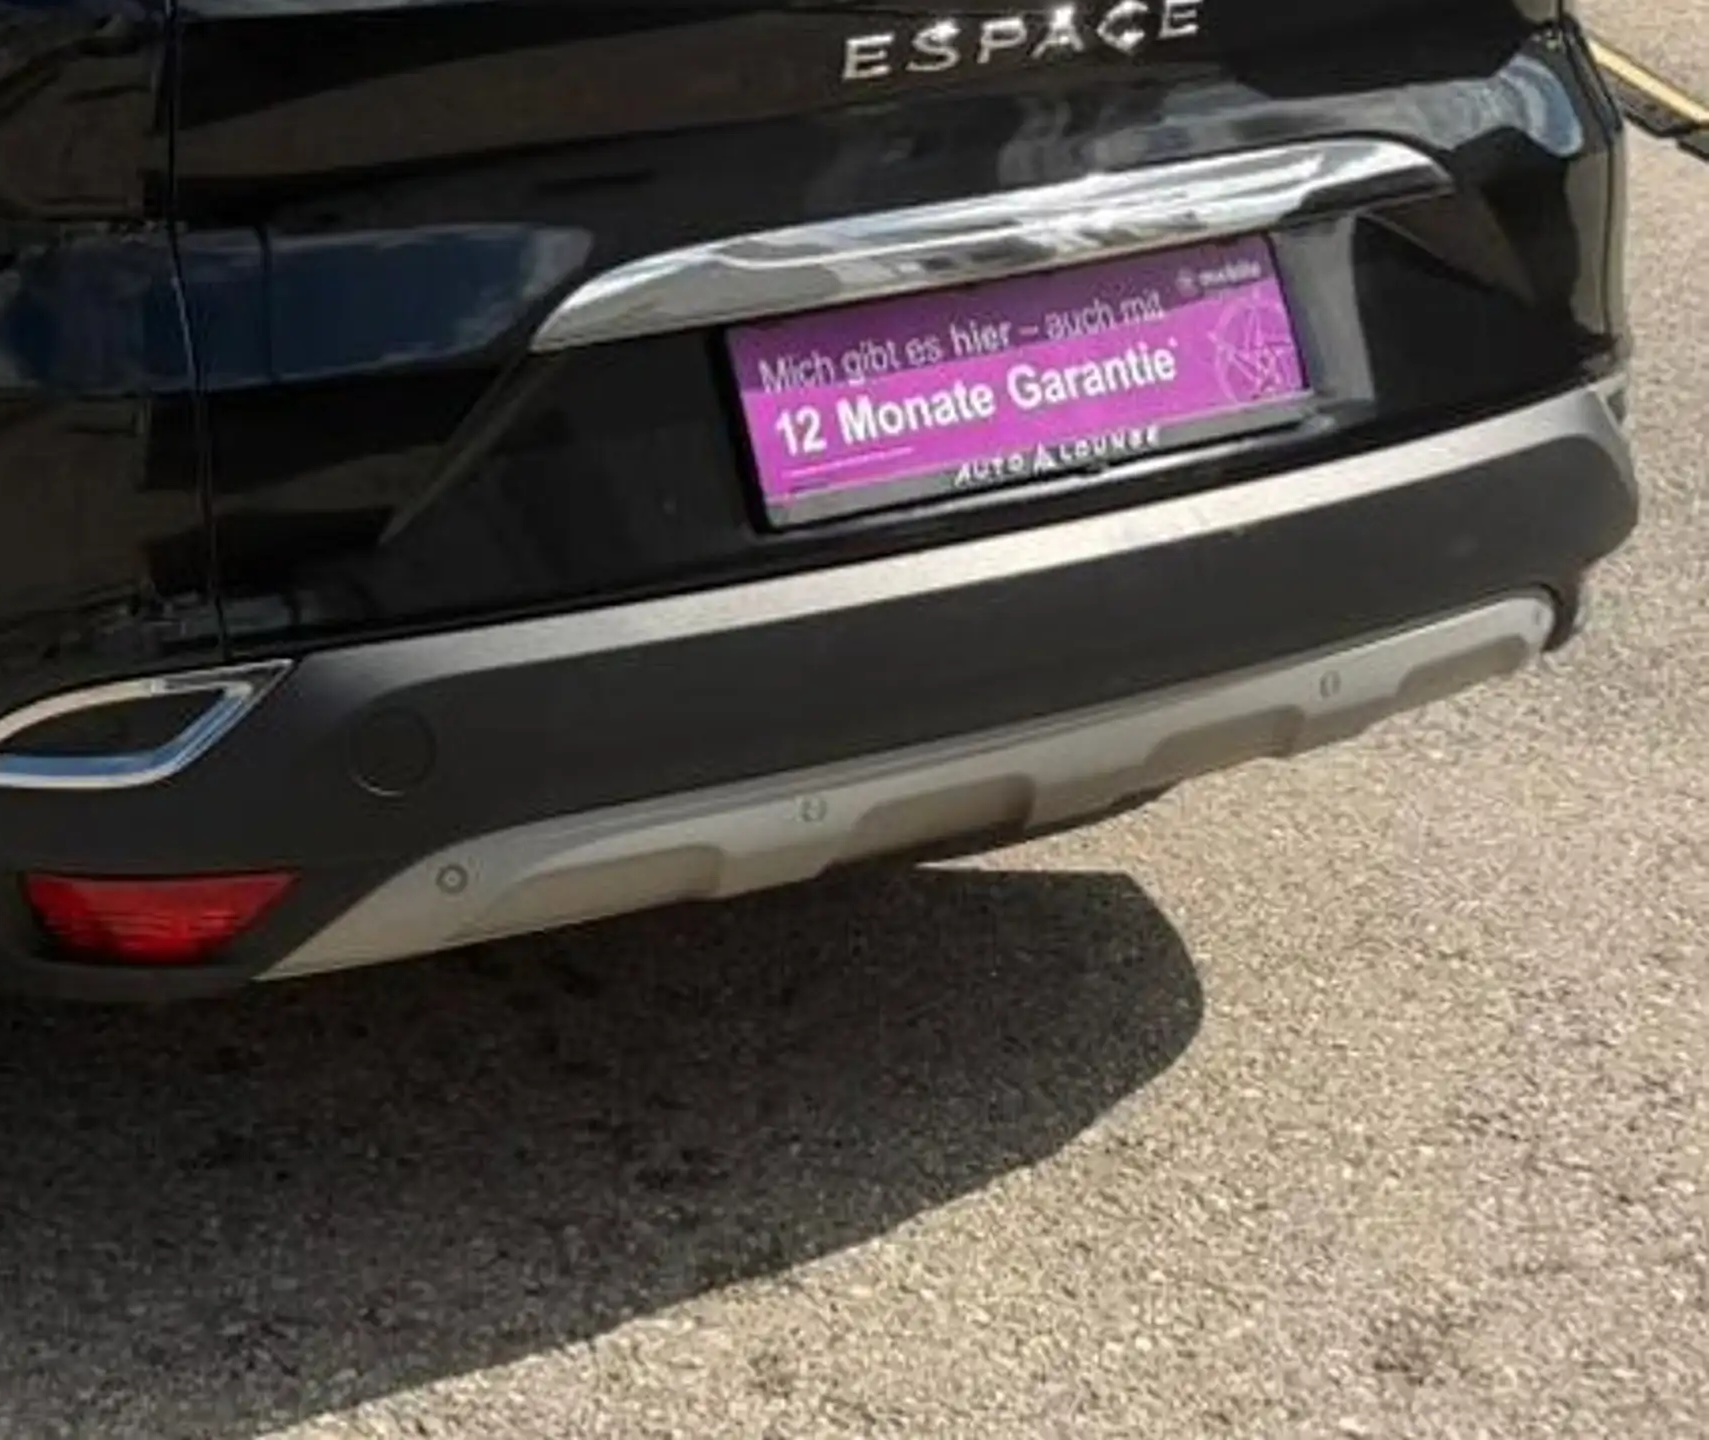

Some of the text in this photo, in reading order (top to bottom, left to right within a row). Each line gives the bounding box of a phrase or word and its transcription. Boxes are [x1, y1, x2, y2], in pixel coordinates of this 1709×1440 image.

[758, 348, 835, 394] Mich
[843, 337, 902, 386] gibt
[904, 334, 945, 366] es
[949, 318, 1013, 358] hier
[1044, 296, 1115, 342] auch
[1119, 287, 1165, 325] mit
[775, 405, 828, 457] 12
[835, 380, 998, 446] Monate
